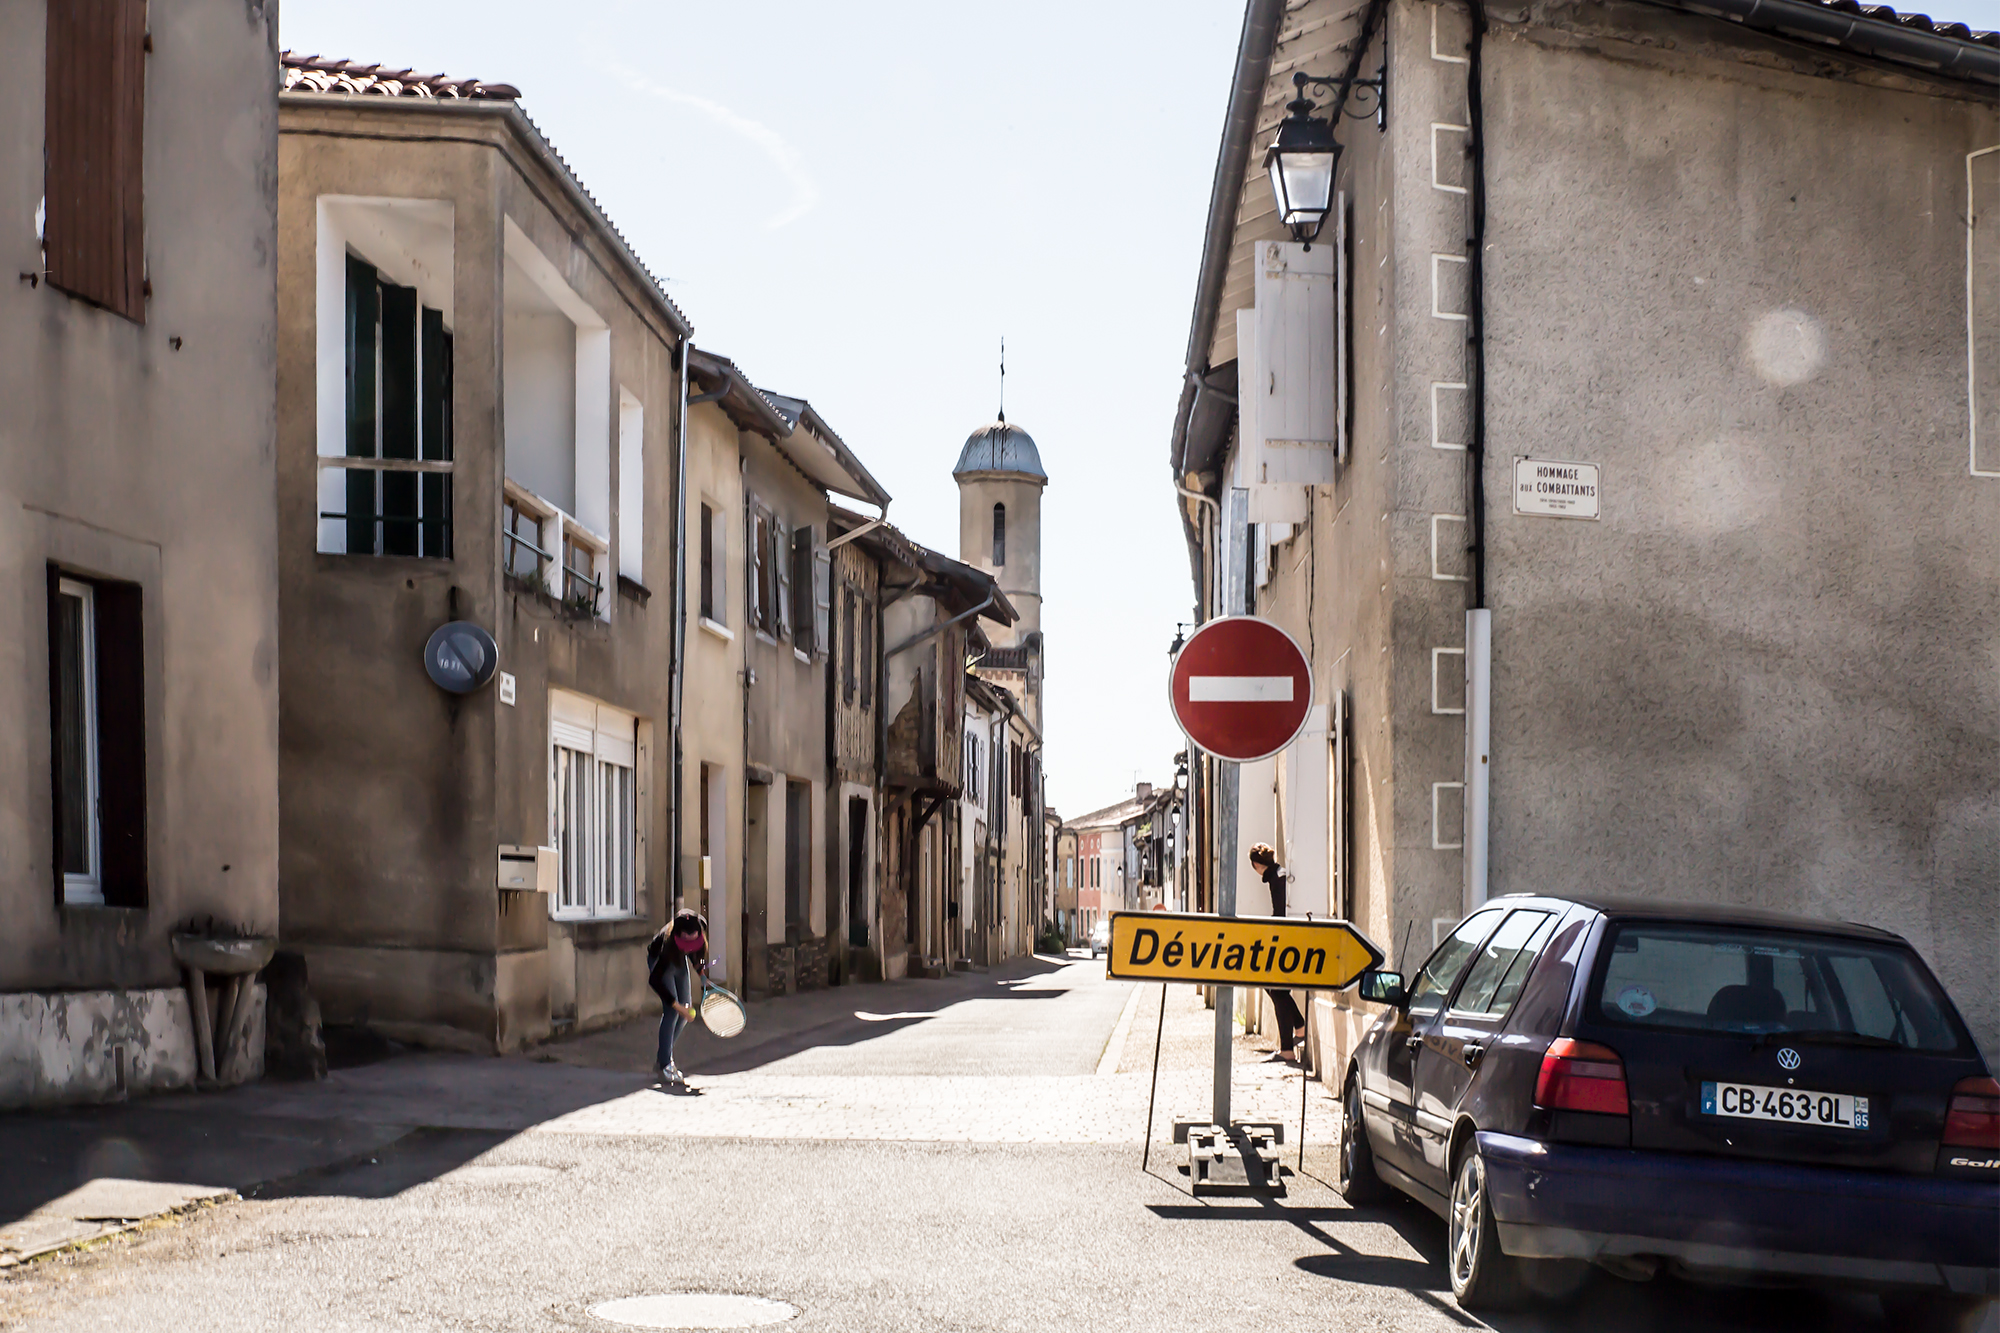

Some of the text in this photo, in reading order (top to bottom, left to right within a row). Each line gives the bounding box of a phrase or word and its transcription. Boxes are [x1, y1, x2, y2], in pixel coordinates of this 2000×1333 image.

[1537, 466, 1578, 480] HOMMAGE
[1537, 481, 1595, 497] COMBATTANTS
[1129, 928, 1326, 974] Déviation
[1706, 1101, 1712, 1110] F
[1722, 1086, 1850, 1125] CB-463-QL
[1855, 1113, 1869, 1127] 85
